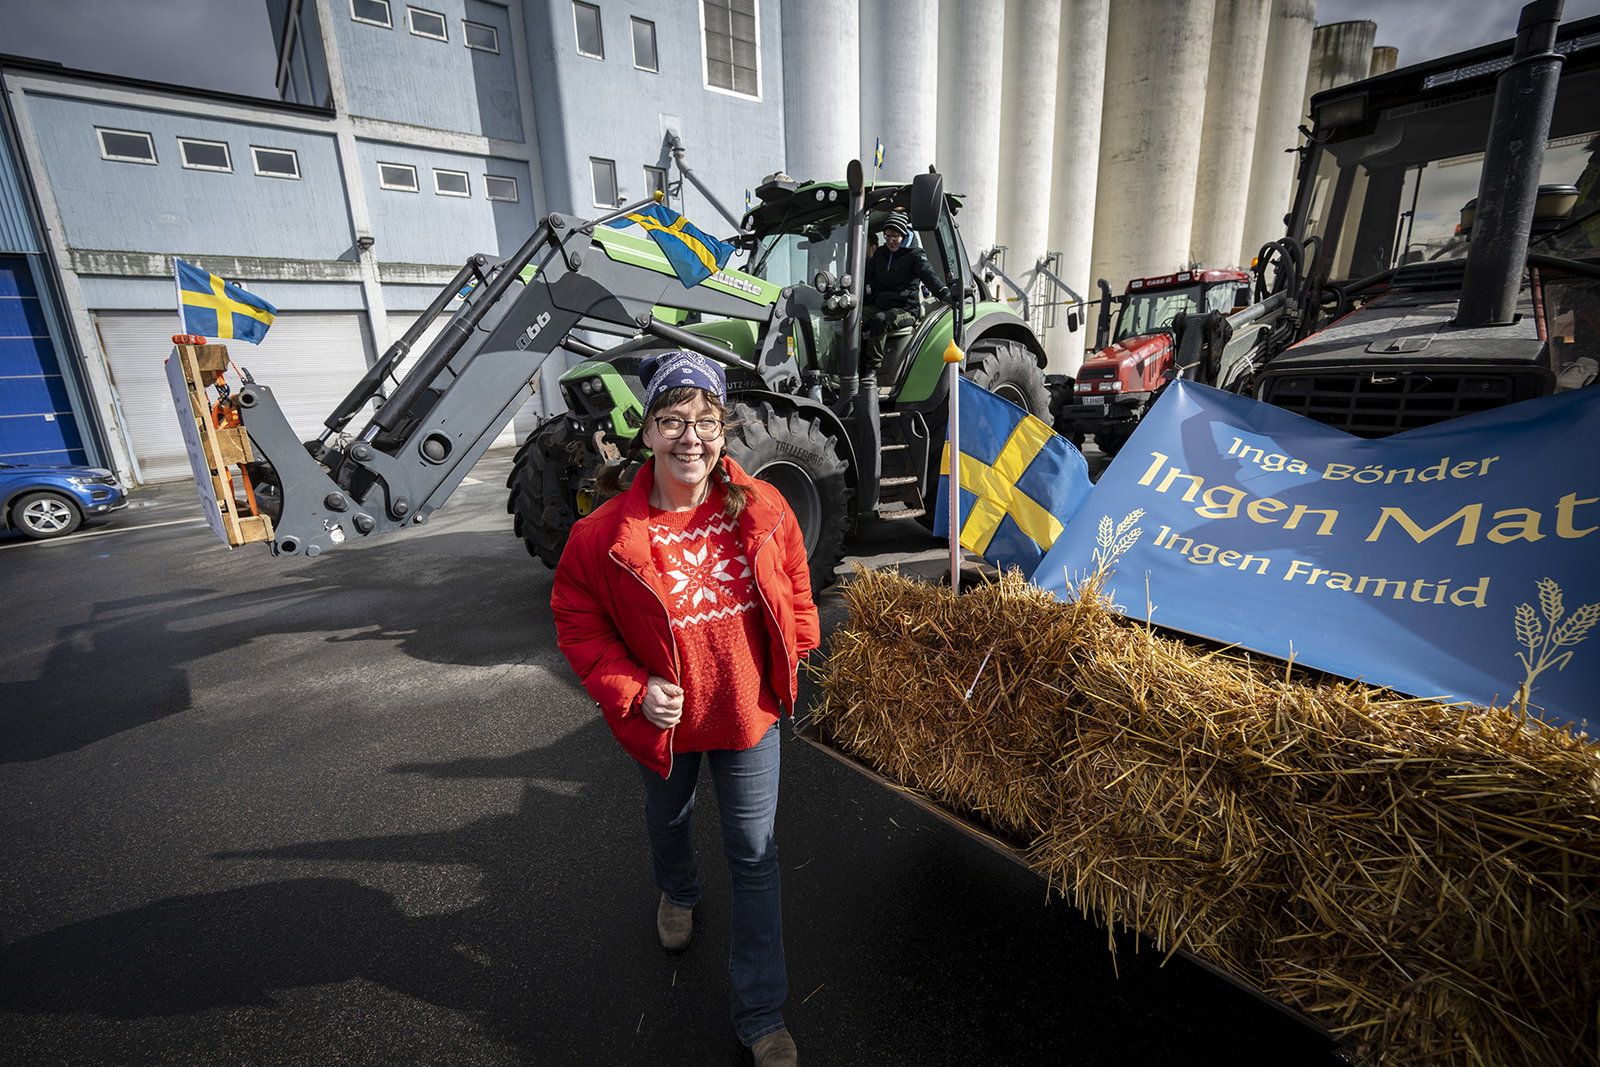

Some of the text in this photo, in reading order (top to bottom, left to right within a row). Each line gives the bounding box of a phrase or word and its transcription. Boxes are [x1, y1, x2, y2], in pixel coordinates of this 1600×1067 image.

[1146, 278, 1165, 286] CASE
[775, 440, 824, 467] TRELLEBORG
[1227, 437, 1500, 484] Inga Bönder
[1137, 451, 1600, 546] Ingen Mat
[1153, 525, 1271, 575] Ingen
